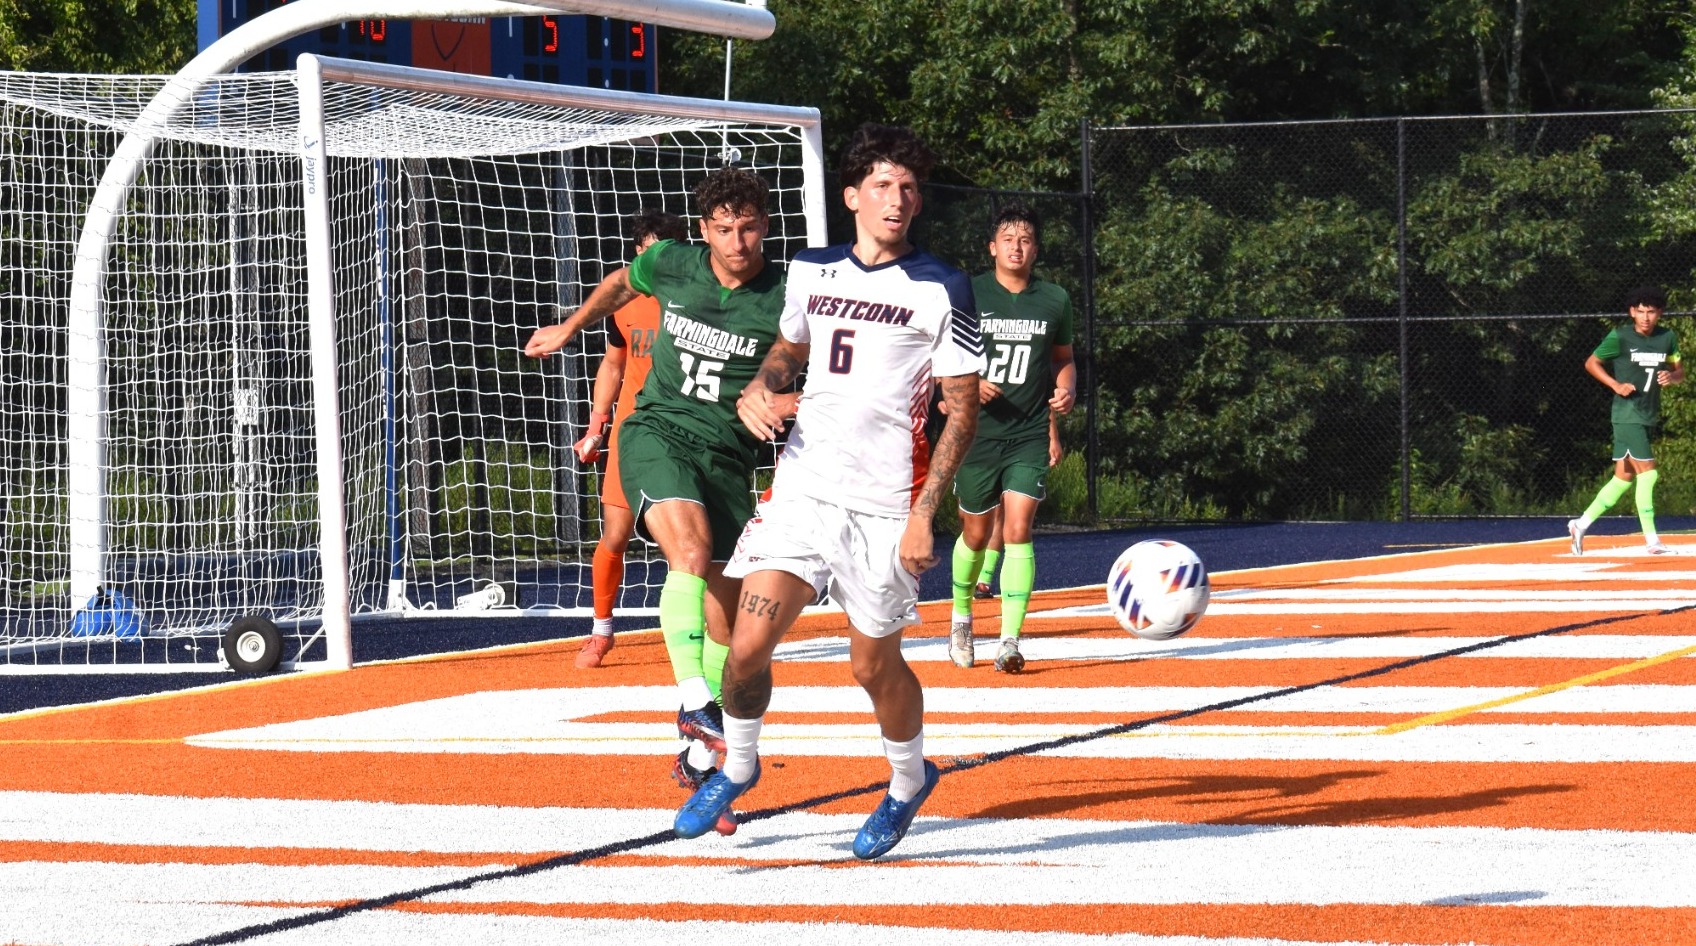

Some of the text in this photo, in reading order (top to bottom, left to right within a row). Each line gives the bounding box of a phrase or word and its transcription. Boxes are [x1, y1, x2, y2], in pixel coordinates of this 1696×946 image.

[305, 156, 317, 195] jaypro
[807, 294, 915, 326] WESTCONN
[980, 318, 1048, 335] FARMINGDALE
[664, 310, 759, 357] FARMINGDALE
[676, 337, 728, 359] STATE
[829, 328, 856, 375] 6
[987, 344, 1031, 384] 20
[680, 352, 724, 402] 15
[1643, 368, 1655, 392] 7
[740, 590, 781, 621] 1974
